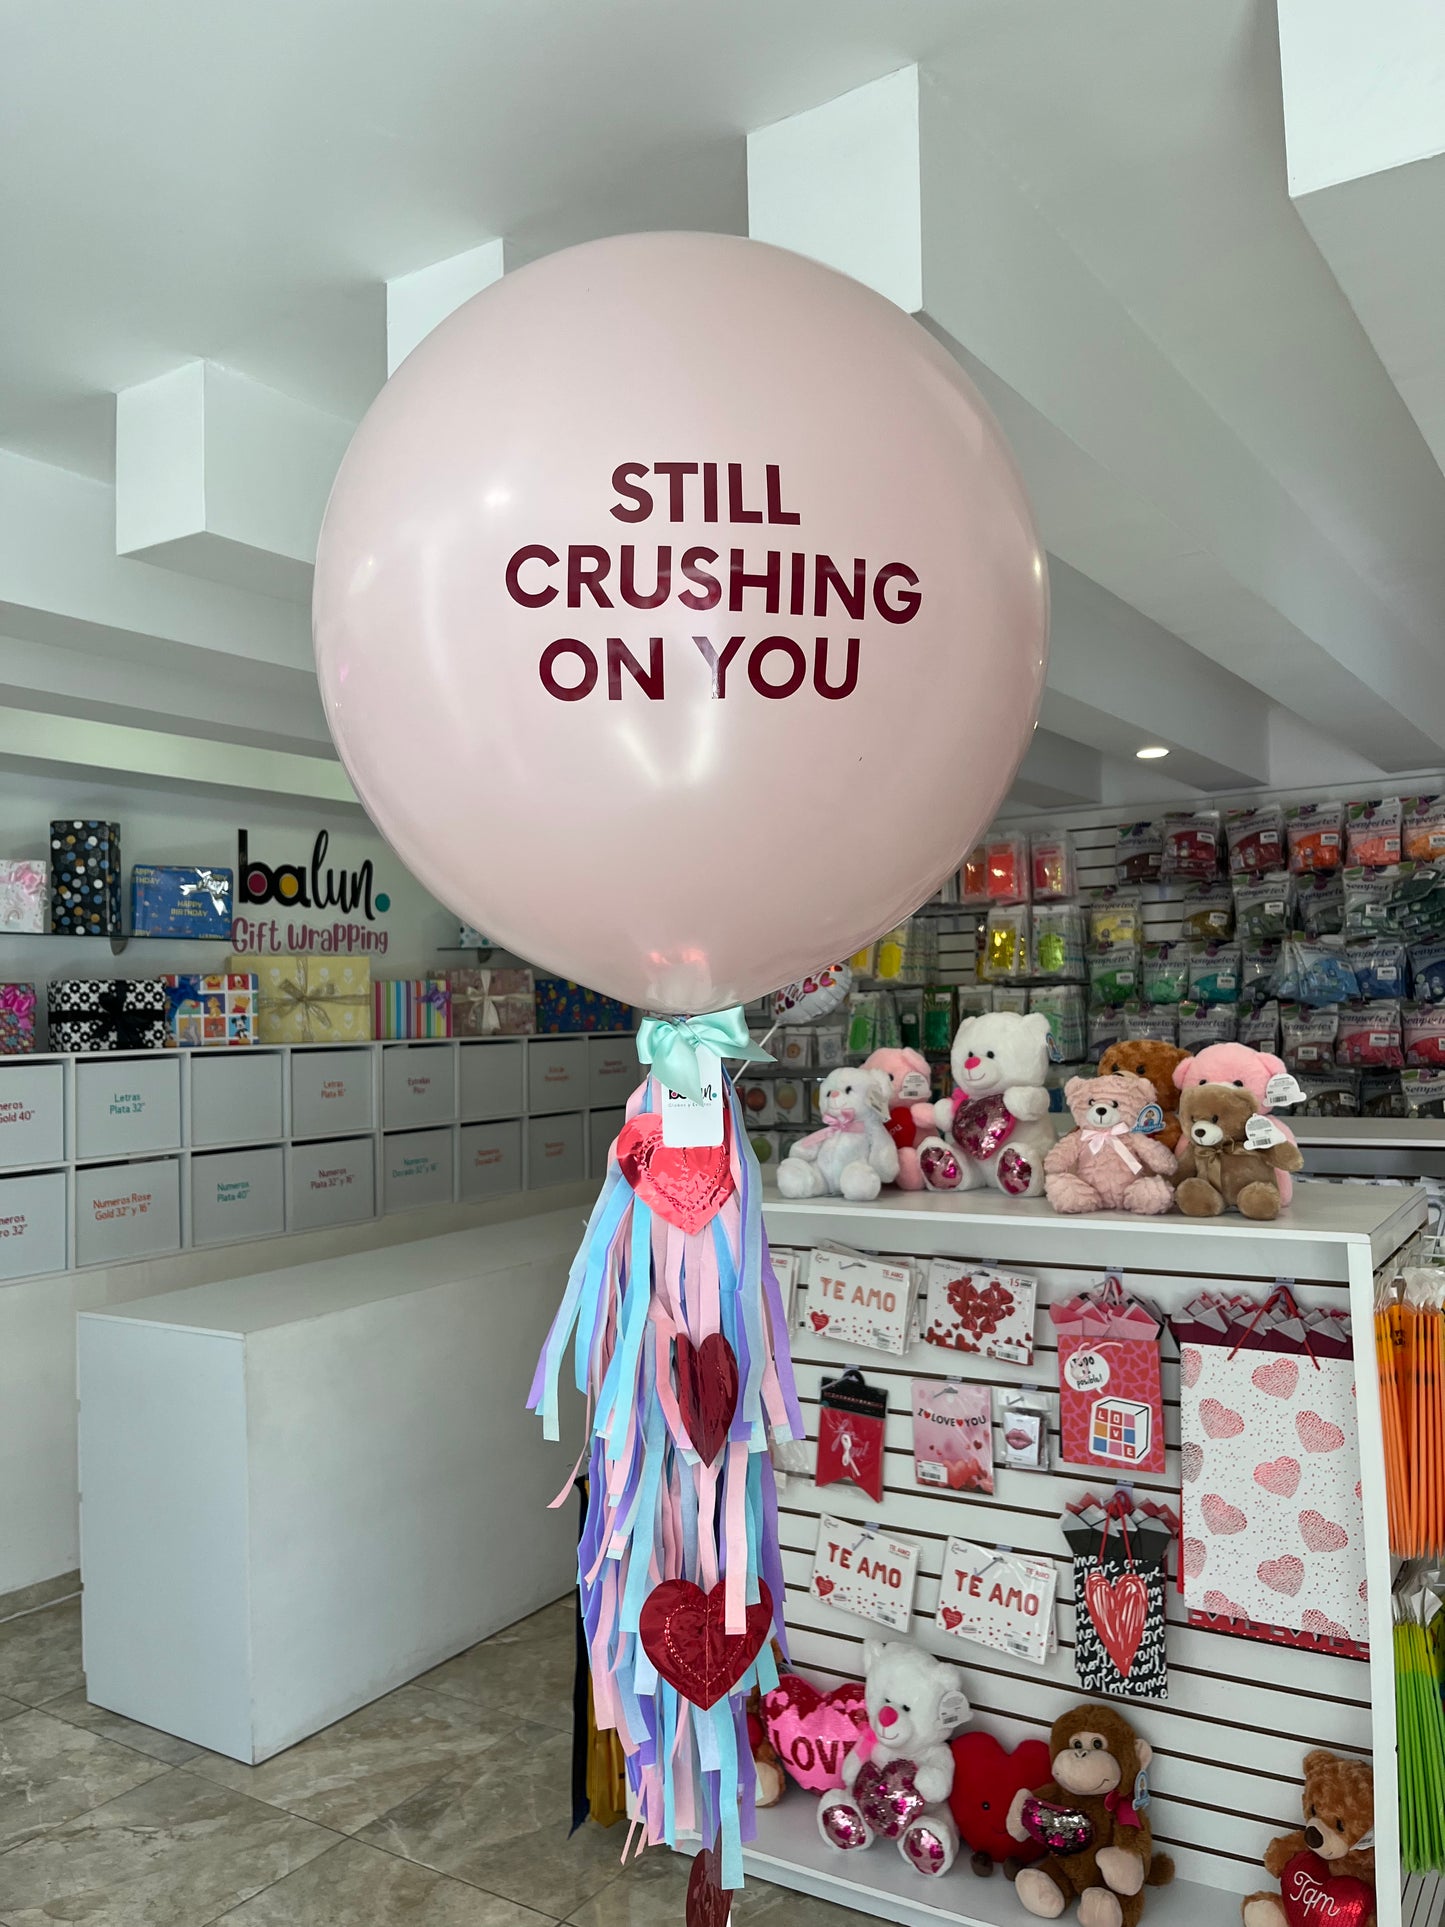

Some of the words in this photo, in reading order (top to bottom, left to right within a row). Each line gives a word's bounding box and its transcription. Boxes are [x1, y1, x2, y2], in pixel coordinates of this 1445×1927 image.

[609, 461, 801, 526] STILL
[505, 544, 922, 625] CRUSHING
[539, 637, 665, 702] ON
[691, 635, 861, 701] YOU
[170, 907, 209, 919] BIRTHDAY
[177, 899, 203, 910] HAPPY
[231, 917, 282, 954] Gift
[287, 921, 389, 955] Wrapping
[1338, 1012, 1390, 1028] Sempertex
[114, 1093, 141, 1103] Letras
[109, 1103, 131, 1115] Plata
[217, 1180, 250, 1191] Numeros
[93, 1196, 130, 1210] Numeros
[131, 1192, 152, 1203] Rose
[217, 1192, 236, 1203] Plata
[95, 1208, 115, 1222] Gold
[1009, 1277, 1020, 1288] 15
[820, 1276, 846, 1301] TE
[851, 1285, 896, 1313] AMO
[917, 1407, 924, 1417] I
[931, 1413, 956, 1428] LOVE
[964, 1414, 987, 1428] YOU
[827, 1541, 852, 1570] TE
[857, 1557, 902, 1590] AMO
[954, 1568, 980, 1598] TE
[988, 1581, 1040, 1617] AMO
